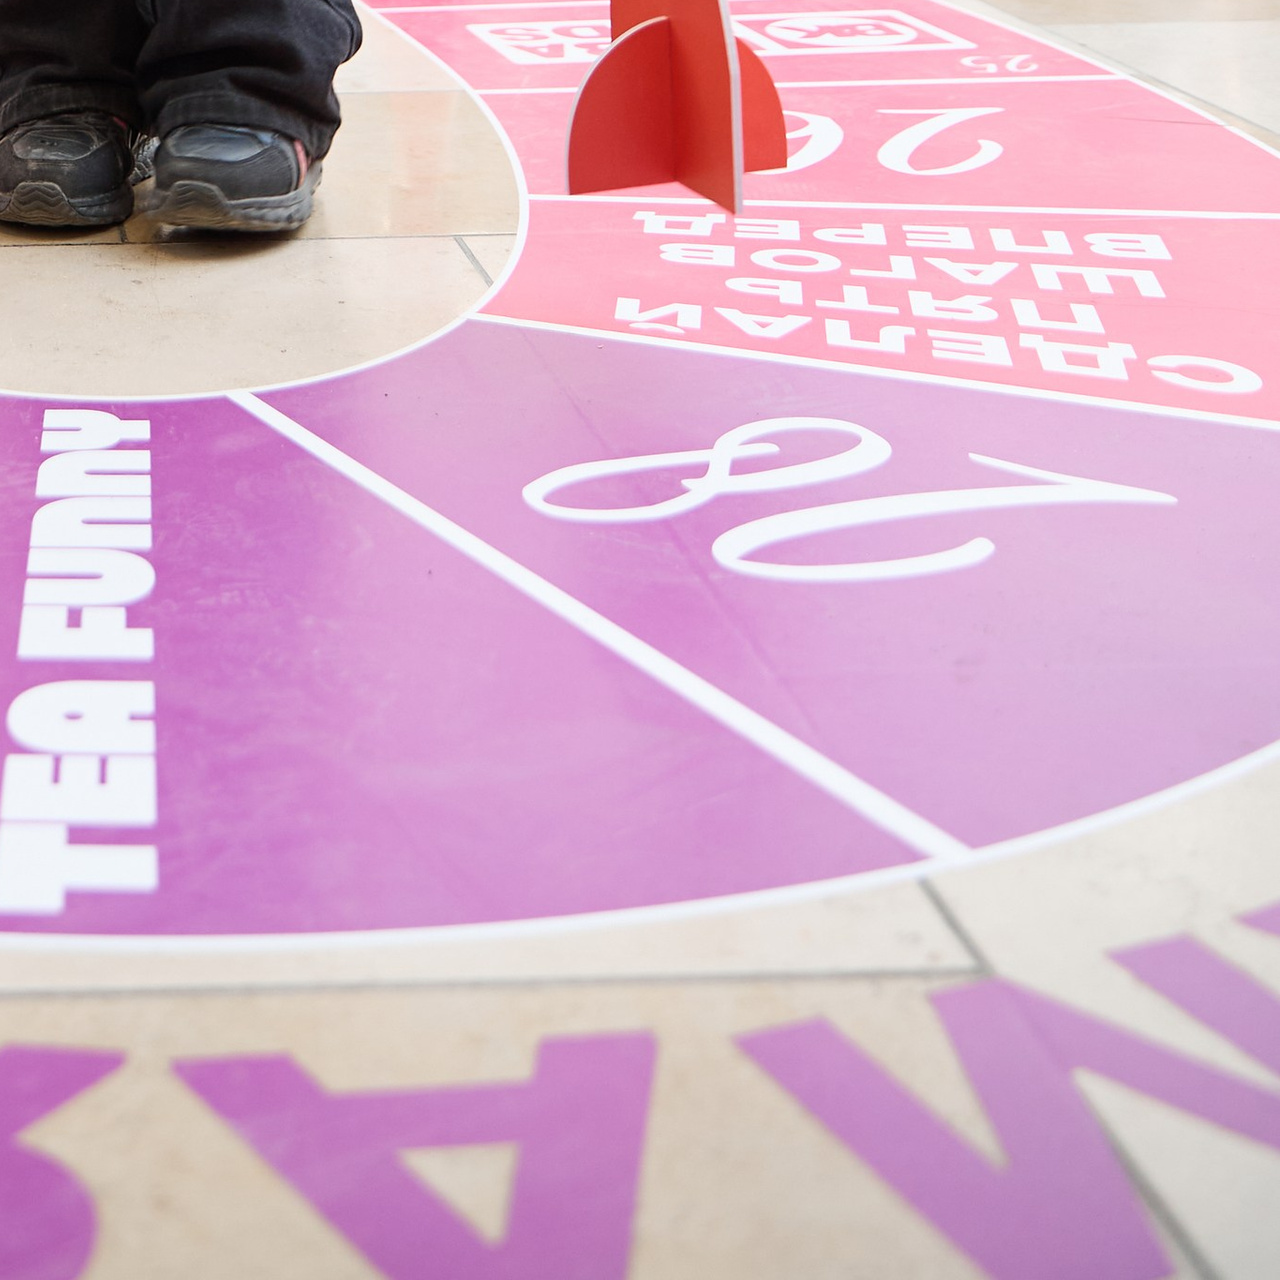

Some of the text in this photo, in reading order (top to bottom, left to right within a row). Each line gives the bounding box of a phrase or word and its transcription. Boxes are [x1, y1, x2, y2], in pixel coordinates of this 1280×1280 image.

[960, 54, 1039, 74] 25
[633, 210, 1174, 261] ВПЕРЕД
[660, 242, 1167, 299] ШАГОВ
[725, 277, 1105, 335] ПЯТЬ
[613, 297, 1264, 394] СДЕЛАЙ
[521, 416, 1179, 582] 28
[16, 407, 157, 661] FUNNY
